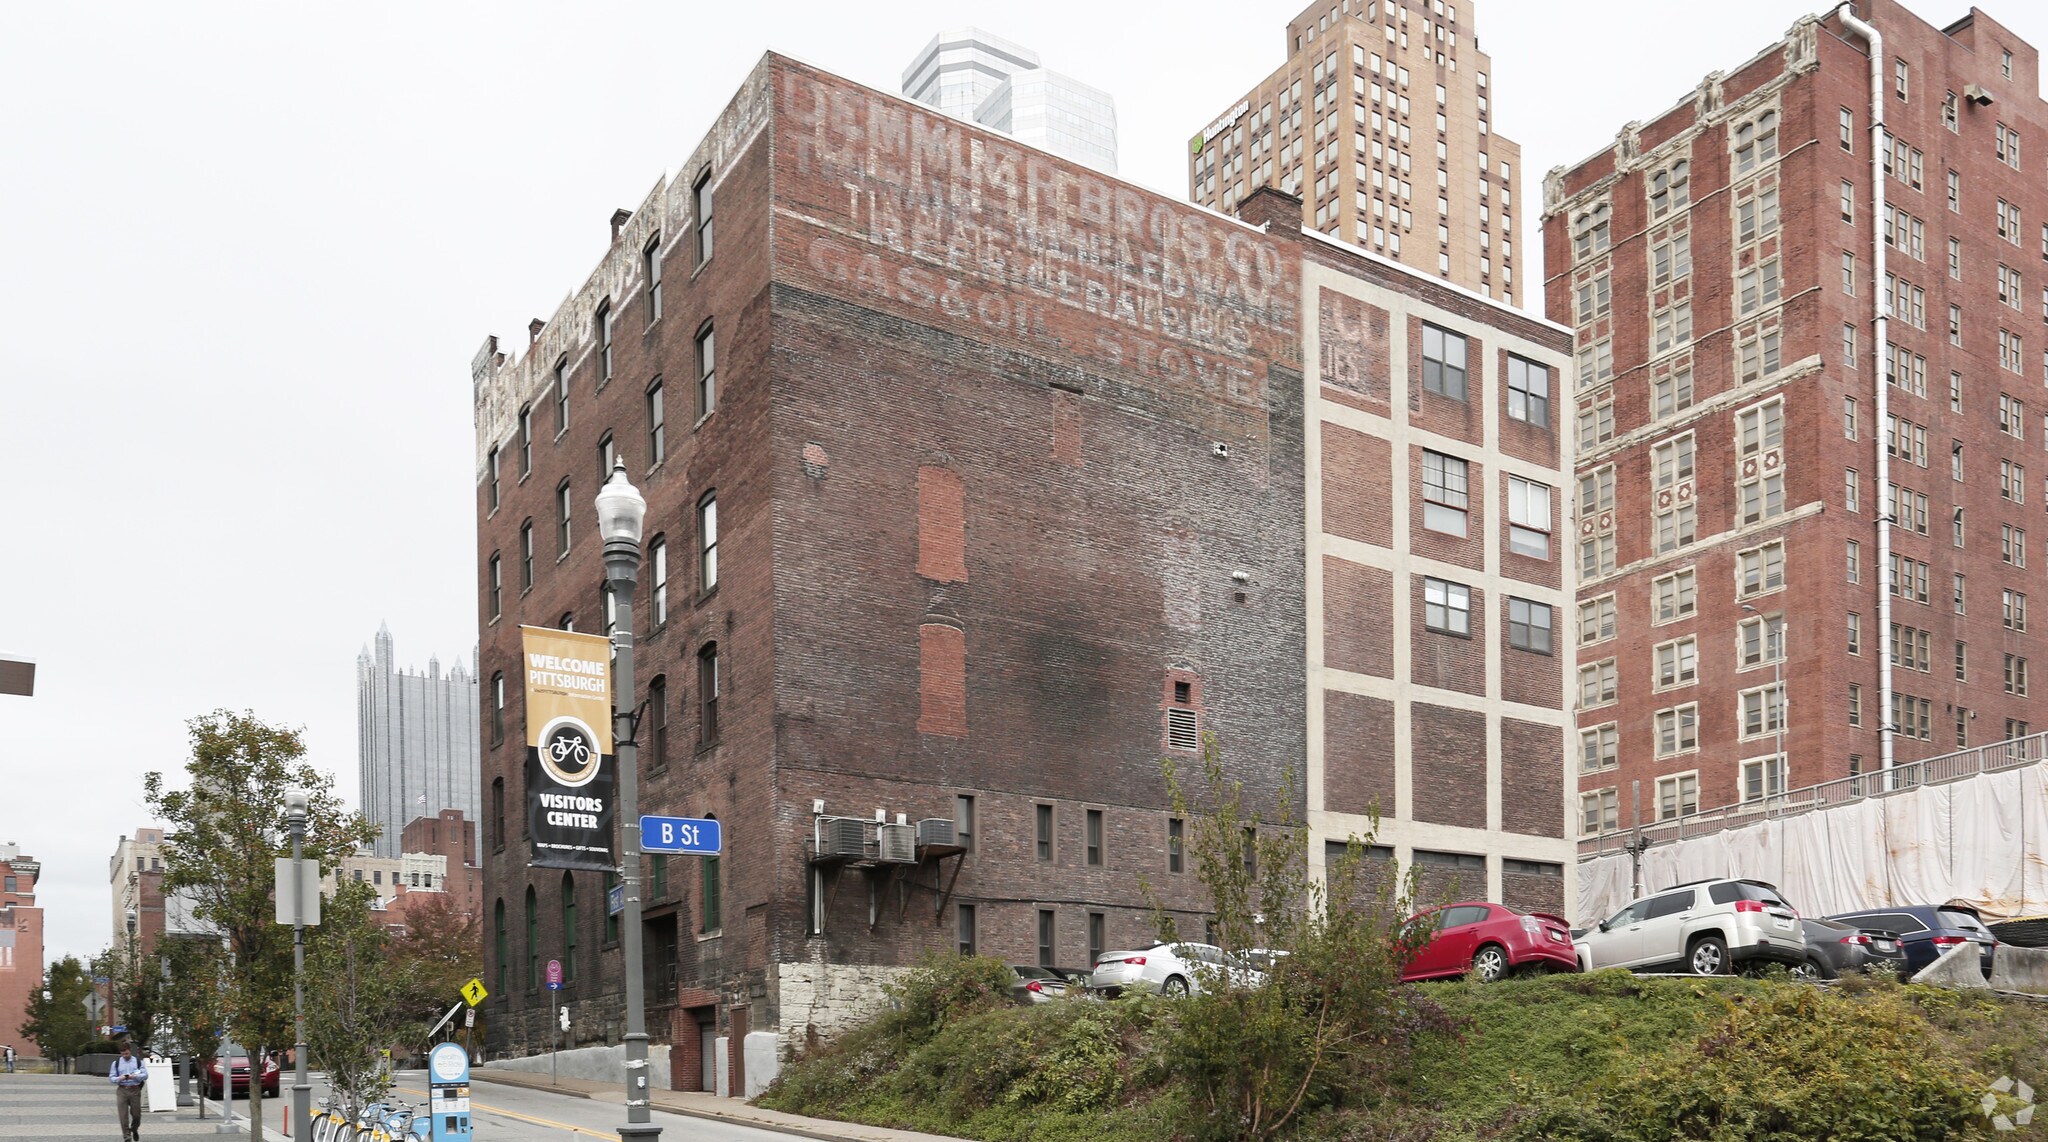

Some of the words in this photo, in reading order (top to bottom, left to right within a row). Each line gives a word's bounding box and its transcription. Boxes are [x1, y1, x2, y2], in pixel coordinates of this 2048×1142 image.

[1203, 99, 1249, 144] Huntington
[529, 653, 604, 676] WELCOME
[529, 670, 605, 693] PITTSBURGH
[539, 793, 603, 812] VISITORS
[547, 811, 598, 829] CENTER
[661, 823, 674, 844] B
[681, 823, 700, 846] St
